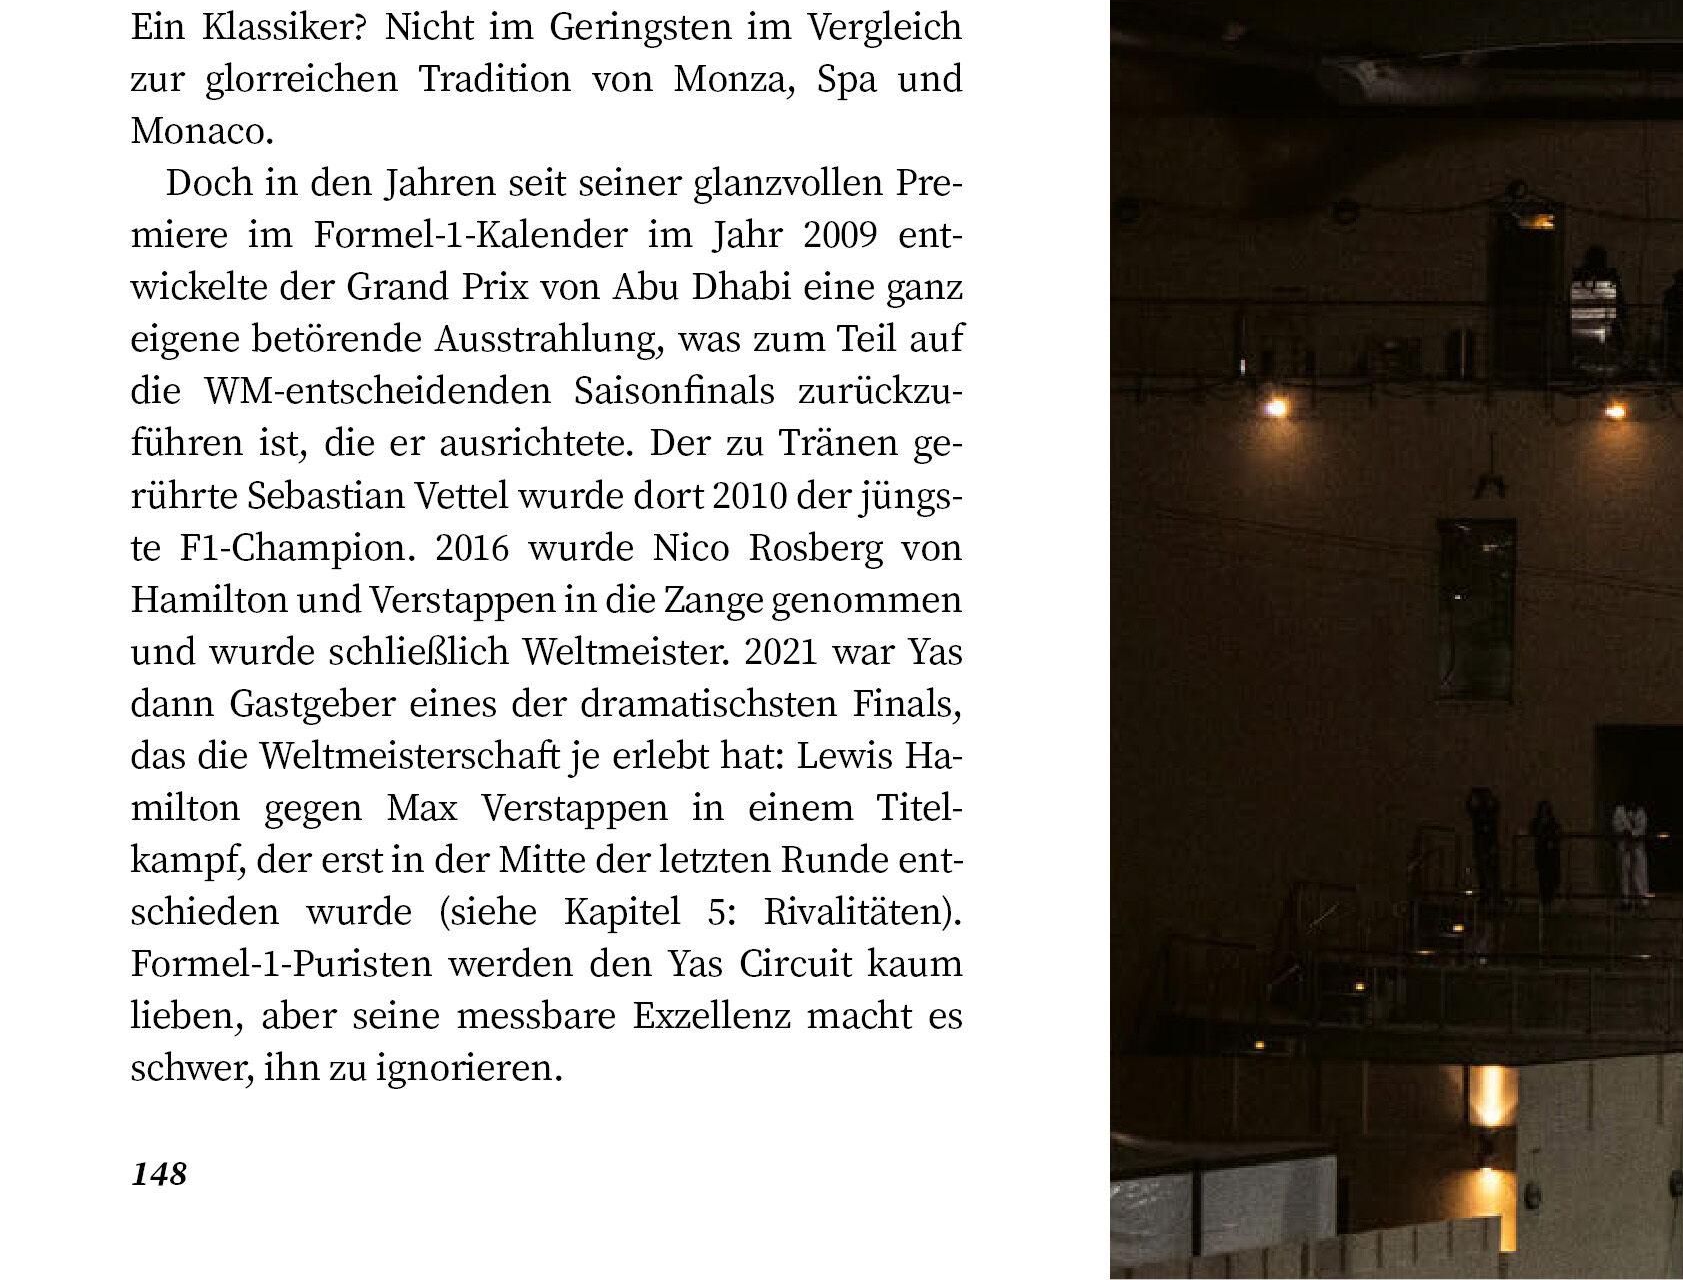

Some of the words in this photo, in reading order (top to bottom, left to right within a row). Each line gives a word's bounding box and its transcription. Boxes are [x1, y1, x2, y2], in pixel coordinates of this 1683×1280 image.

[131, 72, 185, 92] zur
[206, 62, 398, 100] glorreichen
[419, 62, 571, 92] Tradition
[592, 72, 653, 92] von
[675, 65, 794, 99] Monza,
[819, 64, 877, 100] Spa
[898, 62, 963, 92] und
[132, 117, 272, 144] Monaco.
[132, 219, 227, 248] miere
[249, 219, 293, 247] im
[315, 218, 628, 248] Formel-1-Kalender
[649, 219, 693, 247] im
[712, 218, 783, 253] Jahr
[805, 221, 876, 248] 2009
[899, 224, 962, 248] ent-
[131, 323, 239, 360] eigene
[252, 322, 421, 352] betörende
[434, 322, 663, 360] Ausstrahlung,
[678, 332, 740, 352] was
[754, 332, 826, 352] zum
[837, 322, 896, 352] Teil
[911, 322, 966, 352] auf
[132, 374, 180, 404] die
[204, 374, 551, 404] WM-entscheidenden
[576, 374, 774, 404] Saisonfinals
[799, 374, 962, 404] zurückzu-
[132, 479, 237, 509] rührte
[249, 479, 405, 509] Sebastian
[414, 479, 508, 509] Vettel
[518, 479, 623, 509] wurde
[635, 479, 704, 509] dort
[714, 482, 787, 509] 2010
[798, 479, 852, 509] der
[858, 480, 962, 518] jüngs-
[131, 537, 160, 561] te
[181, 531, 414, 569] F1-Champion.
[437, 534, 508, 561] 2016
[528, 531, 633, 561] wurde
[654, 532, 729, 561] Nico
[750, 531, 883, 569] Rosberg
[901, 541, 962, 561] von
[132, 583, 288, 613] Hamilton
[297, 583, 362, 613] und
[369, 586, 556, 621] Verstappen
[565, 584, 597, 612] in
[606, 583, 655, 613] die
[665, 586, 763, 621] Zange
[772, 593, 962, 621] genommen
[132, 687, 214, 717] dann
[231, 687, 396, 725] Gastgeber
[411, 688, 496, 717] eines
[513, 687, 567, 717] der
[582, 687, 837, 717] dramatischsten
[854, 687, 960, 724] Finals,
[132, 791, 240, 821] milton
[265, 801, 362, 829] gegen
[388, 794, 458, 821] Max
[481, 794, 668, 829] Verstappen
[693, 792, 724, 820] in
[750, 792, 854, 821] einem
[877, 791, 962, 821] Titel-
[132, 895, 279, 925] schieden
[306, 895, 411, 925] wurde
[441, 895, 536, 931] (siehe
[565, 895, 680, 933] Kapitel
[709, 899, 734, 925] 5:
[765, 895, 960, 931] Rivalitäten).
[132, 1051, 253, 1088] schwer,
[265, 1051, 320, 1080] ihn
[330, 1062, 366, 1081] zu
[377, 1052, 561, 1089] ignorieren.
[132, 1162, 186, 1186] 148
